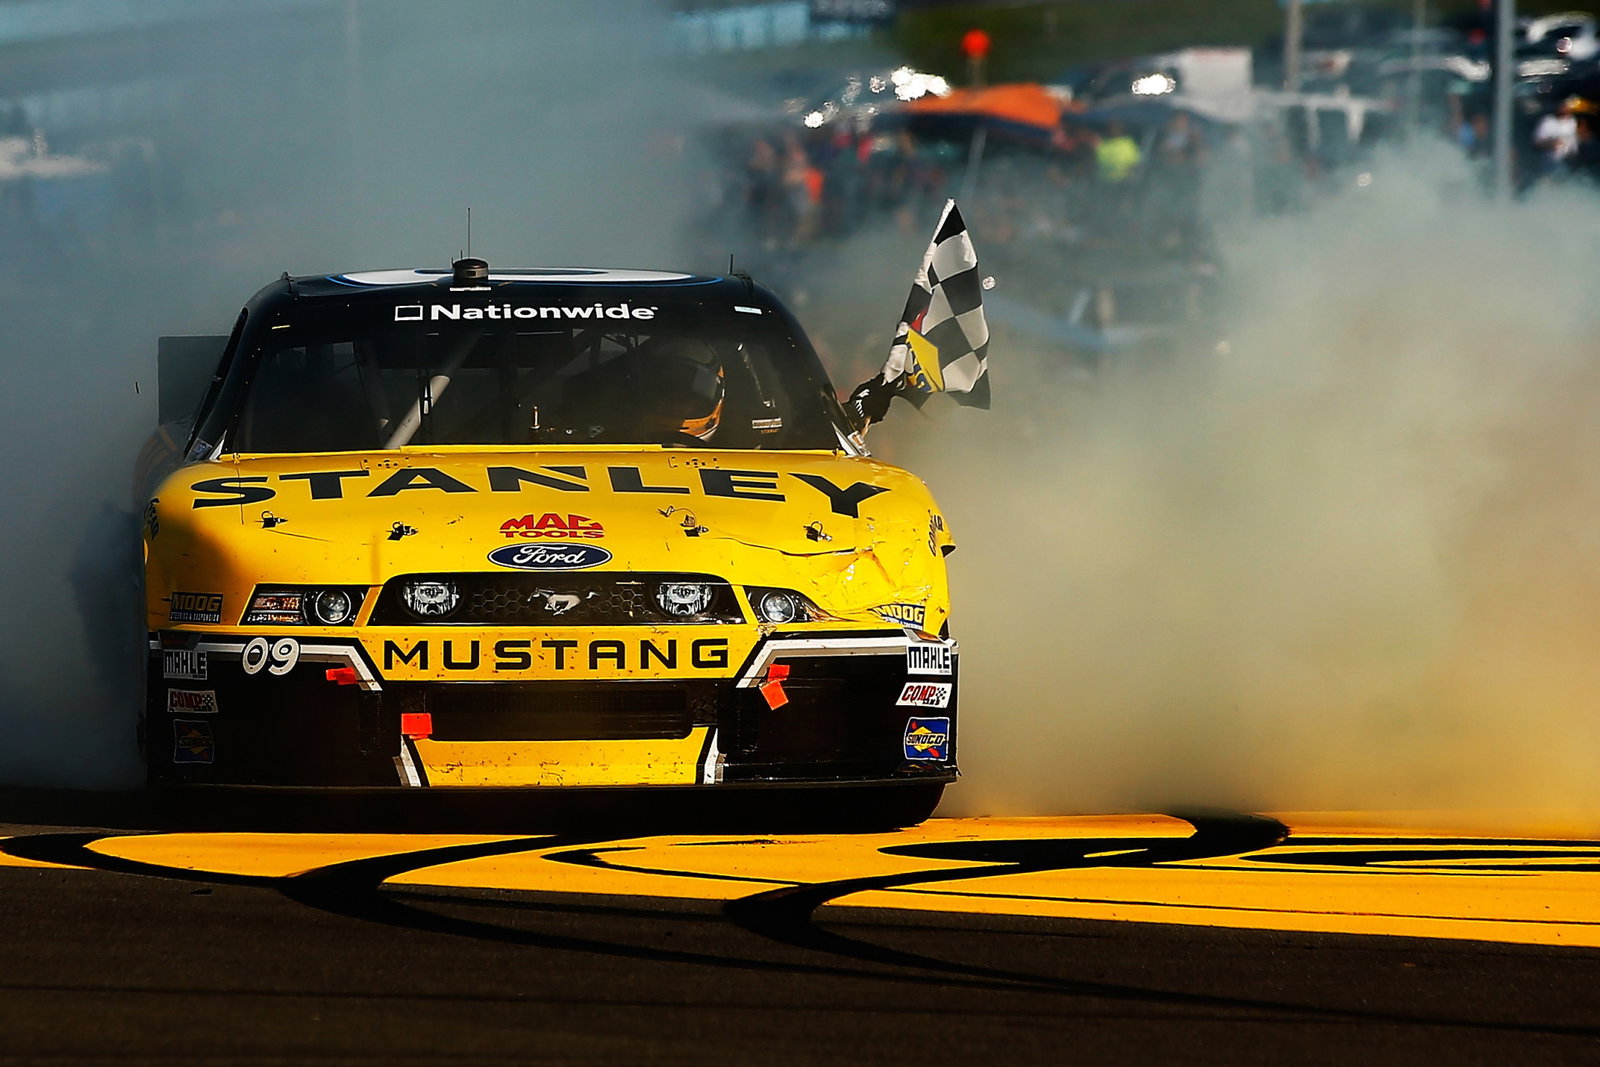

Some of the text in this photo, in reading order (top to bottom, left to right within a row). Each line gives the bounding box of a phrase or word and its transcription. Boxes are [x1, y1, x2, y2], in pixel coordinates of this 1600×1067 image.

[430, 303, 655, 321] Nationwide
[190, 465, 891, 518] STANLEY
[500, 513, 603, 530] MAC
[500, 530, 604, 538] TOOLS
[513, 545, 587, 564] Ford
[172, 594, 222, 612] MOOG
[873, 604, 925, 624] MOOG
[165, 650, 206, 675] MAHLE
[243, 637, 300, 676] 09
[383, 638, 729, 670] MUSTANG
[908, 646, 950, 669] MAHLE
[169, 691, 203, 708] COMP
[901, 685, 937, 701] COMP
[907, 734, 944, 744] SUNOCO
